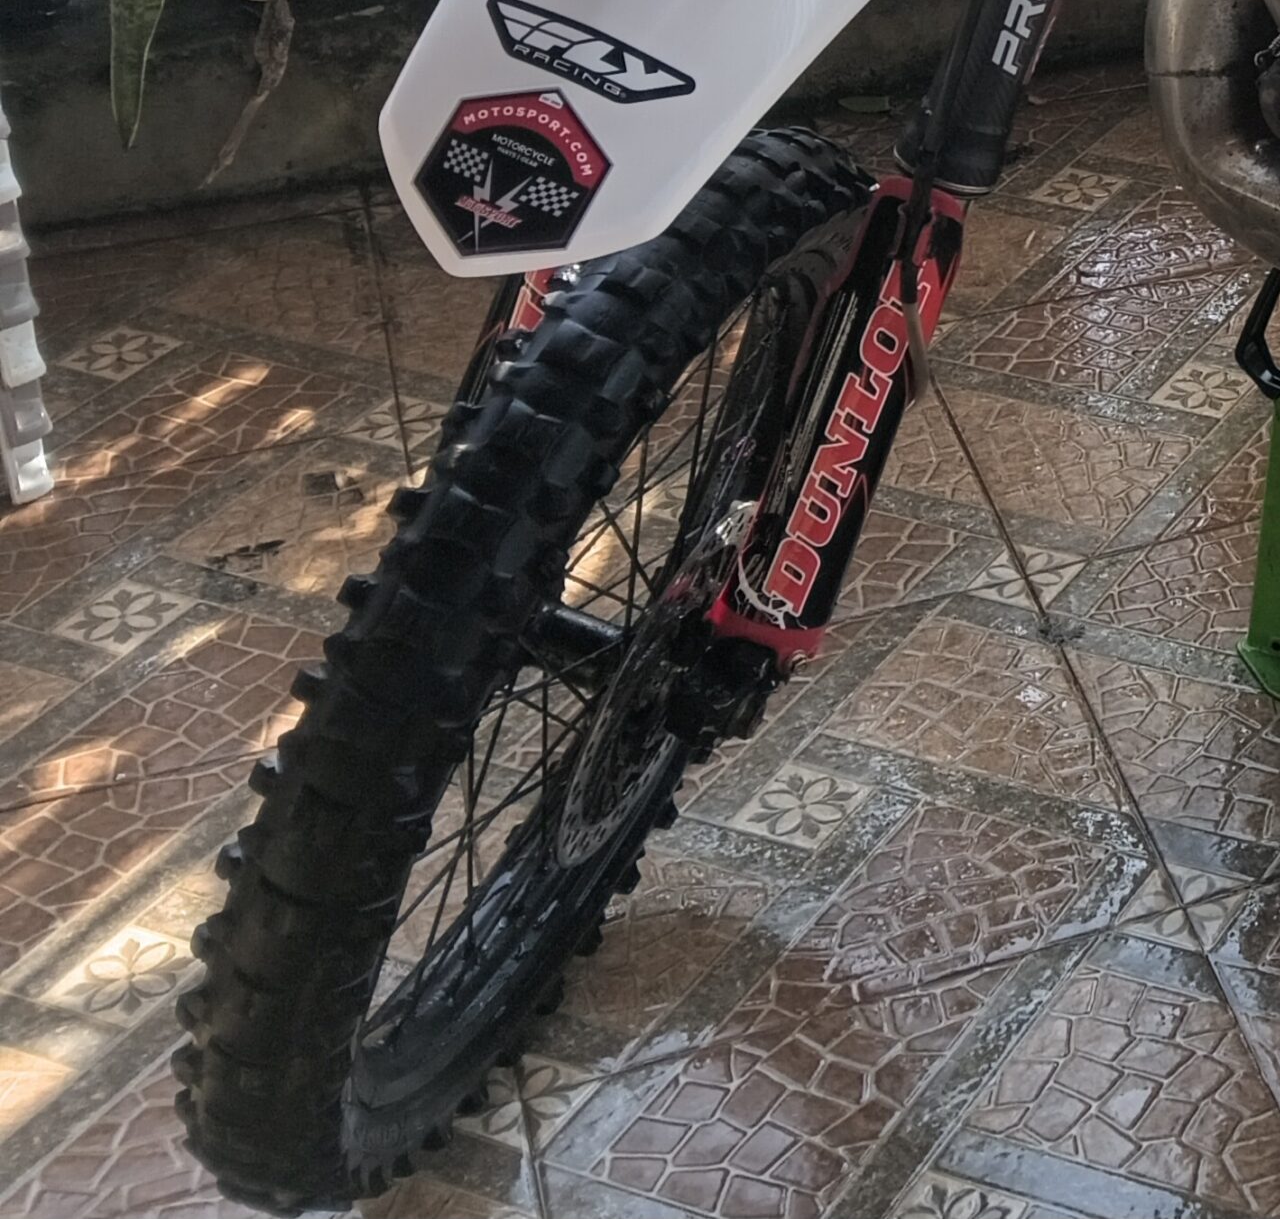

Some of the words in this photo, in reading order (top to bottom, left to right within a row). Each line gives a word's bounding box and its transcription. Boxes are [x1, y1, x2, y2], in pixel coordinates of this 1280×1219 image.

[496, 1, 687, 92] FLY
[512, 43, 622, 96] RACING
[463, 105, 593, 177] MOTOSPORT.COM
[492, 133, 556, 167] MOTORCYCLE
